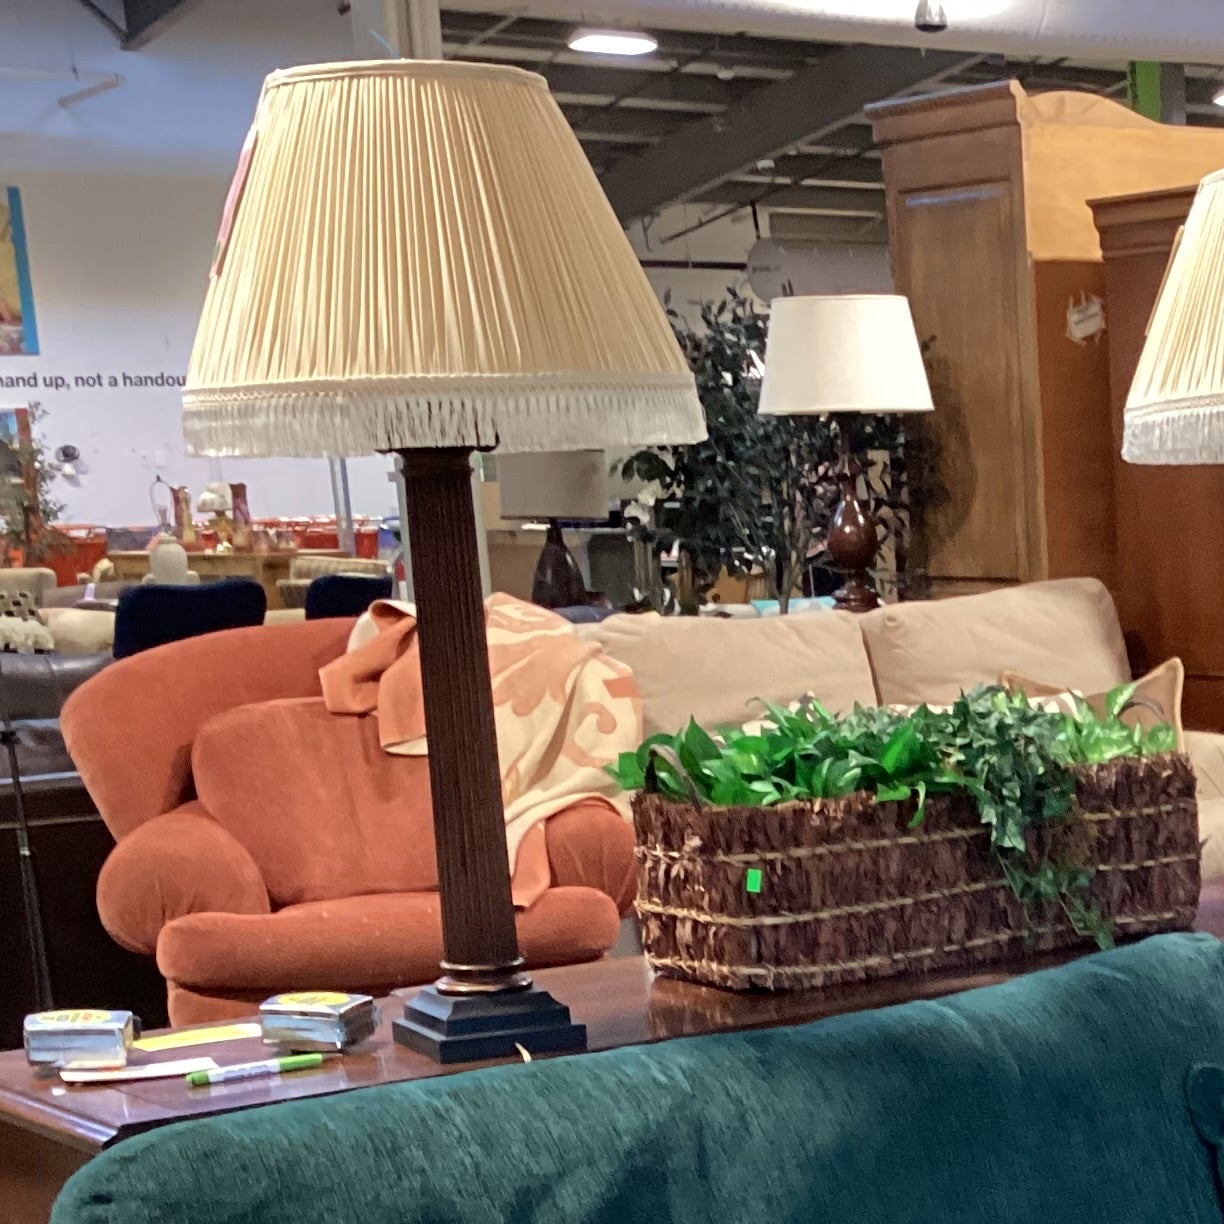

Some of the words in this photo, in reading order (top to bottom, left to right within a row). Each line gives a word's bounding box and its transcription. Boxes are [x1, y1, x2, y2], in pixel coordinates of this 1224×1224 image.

[43, 375, 70, 391] up,
[75, 373, 103, 388] not
[108, 376, 118, 387] a
[122, 371, 187, 387] handou
